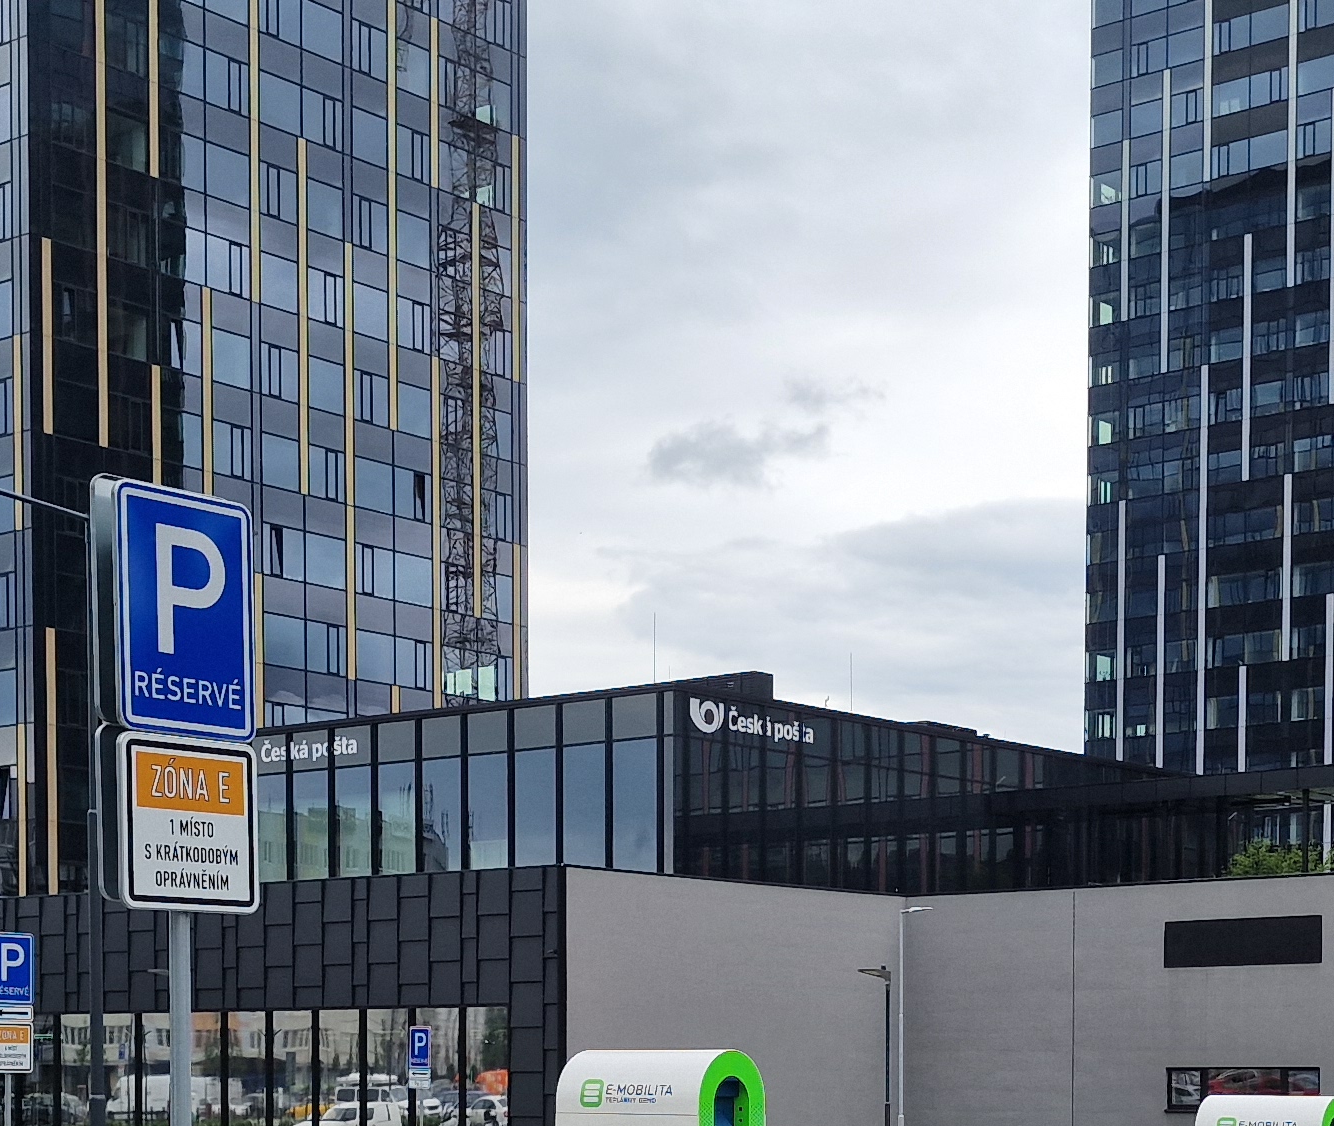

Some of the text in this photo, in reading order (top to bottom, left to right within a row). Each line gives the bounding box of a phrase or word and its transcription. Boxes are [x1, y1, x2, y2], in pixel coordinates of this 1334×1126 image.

[154, 522, 226, 655] P
[133, 667, 242, 711] RÉSERVÉ
[728, 705, 772, 736] Česká
[260, 739, 309, 763] Česká
[150, 757, 231, 804] ZÓNA E
[169, 816, 215, 838] 1 MÍSTO
[144, 841, 239, 866] S KRÁTKODOBÝM
[155, 867, 230, 891] OPRÁVNĚNÍM
[0, 942, 26, 982] P
[414, 1032, 427, 1056] P
[605, 1083, 673, 1096] E-MOBILITA
